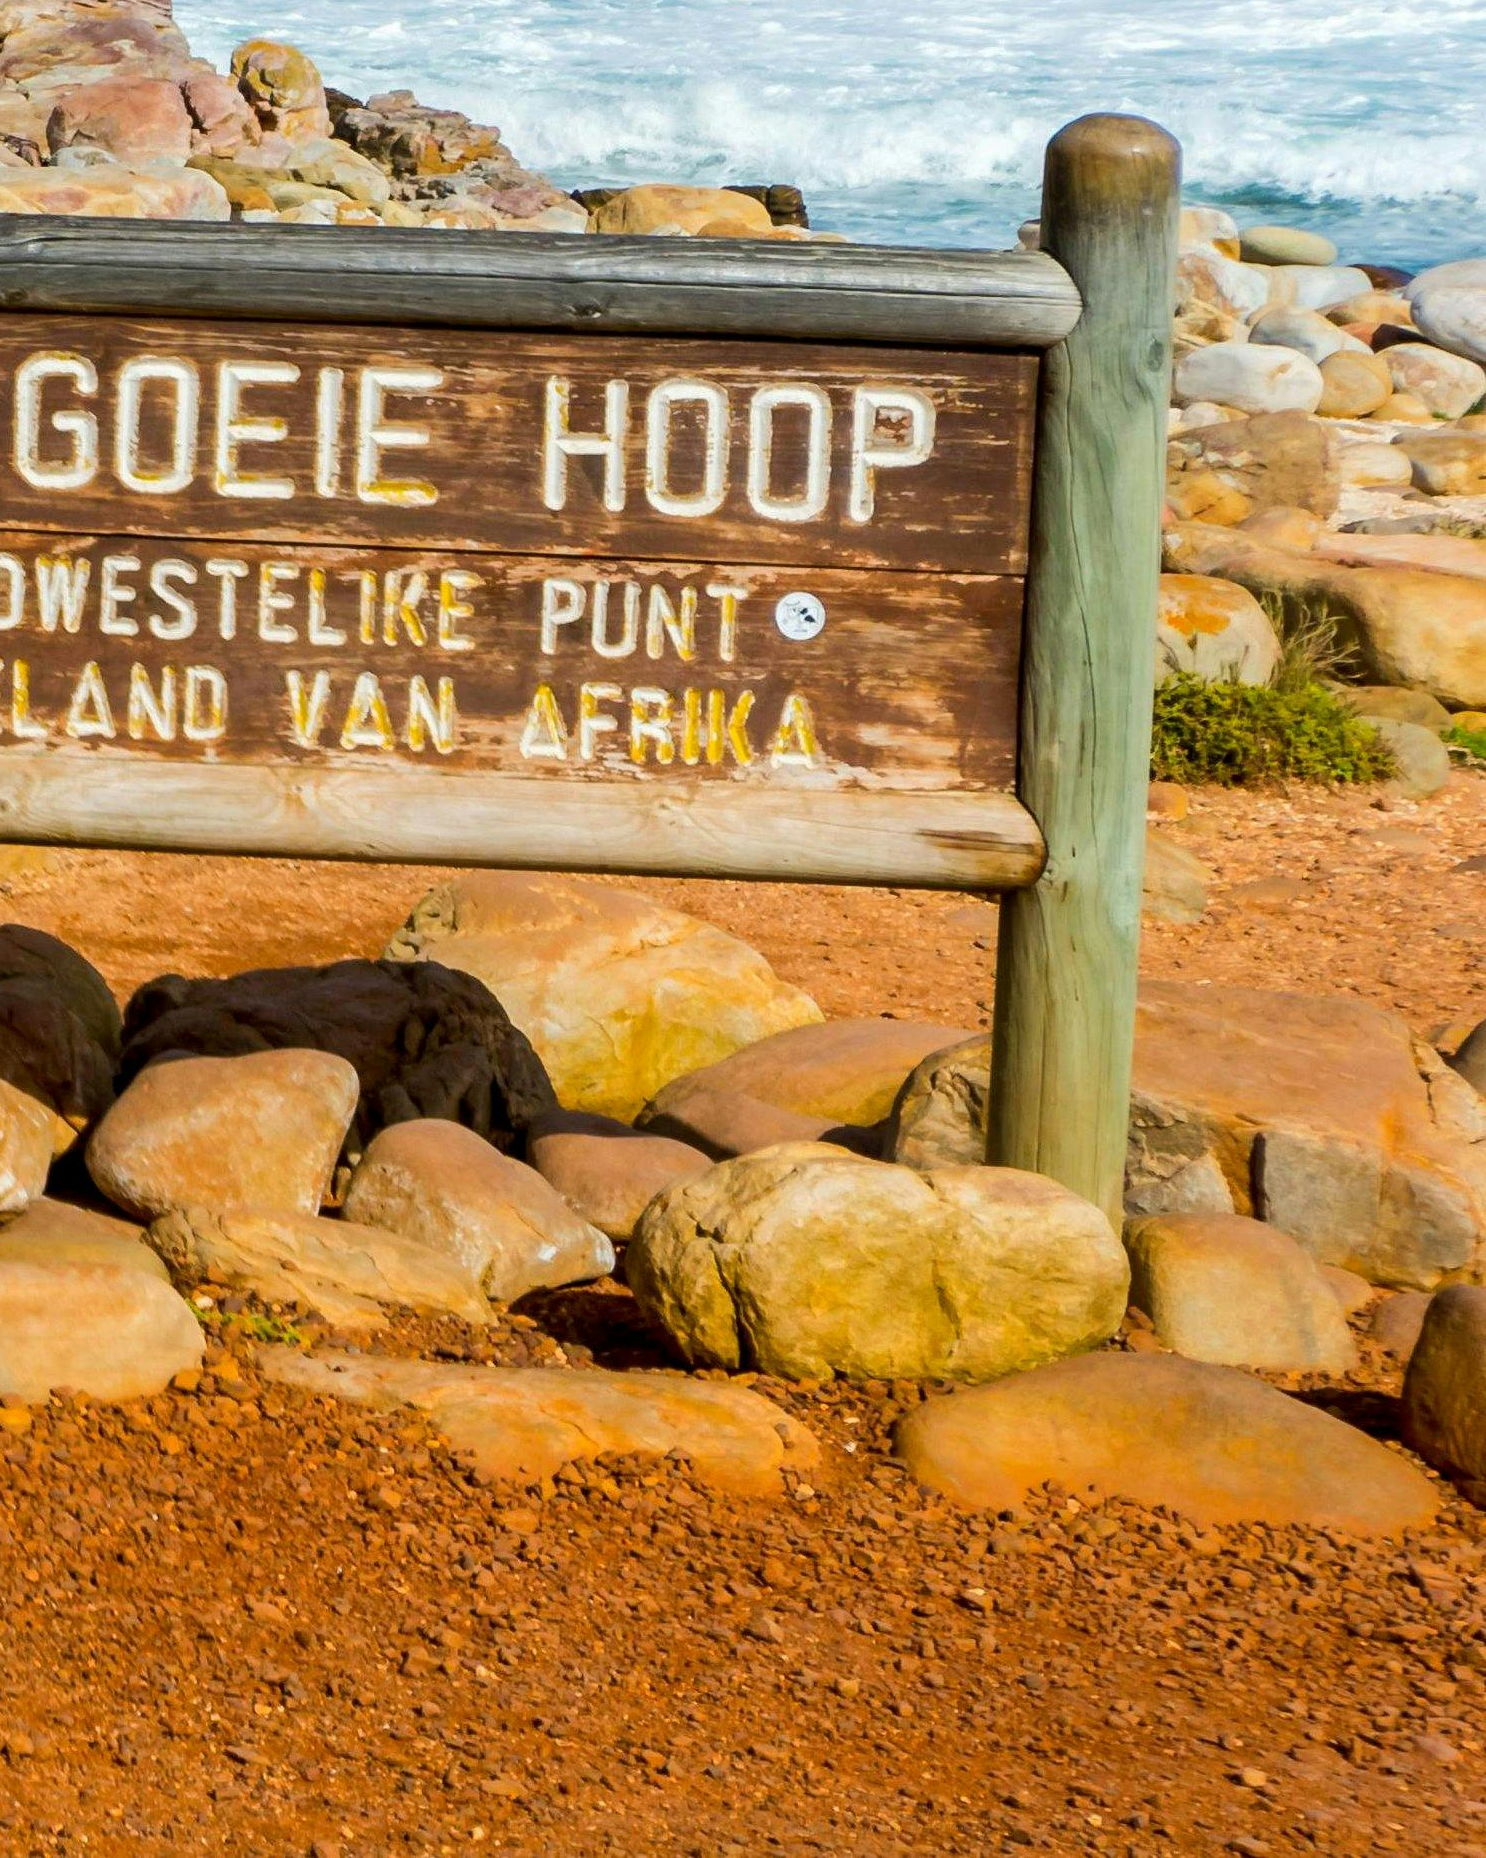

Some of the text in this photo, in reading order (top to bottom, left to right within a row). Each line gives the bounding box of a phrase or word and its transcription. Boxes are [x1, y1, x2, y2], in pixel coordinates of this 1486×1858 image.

[13, 350, 445, 507] GOEIE
[542, 374, 937, 524] HOOP
[540, 578, 748, 663] PUNT
[287, 671, 455, 754] VAN
[518, 682, 818, 767] AFRIKA
